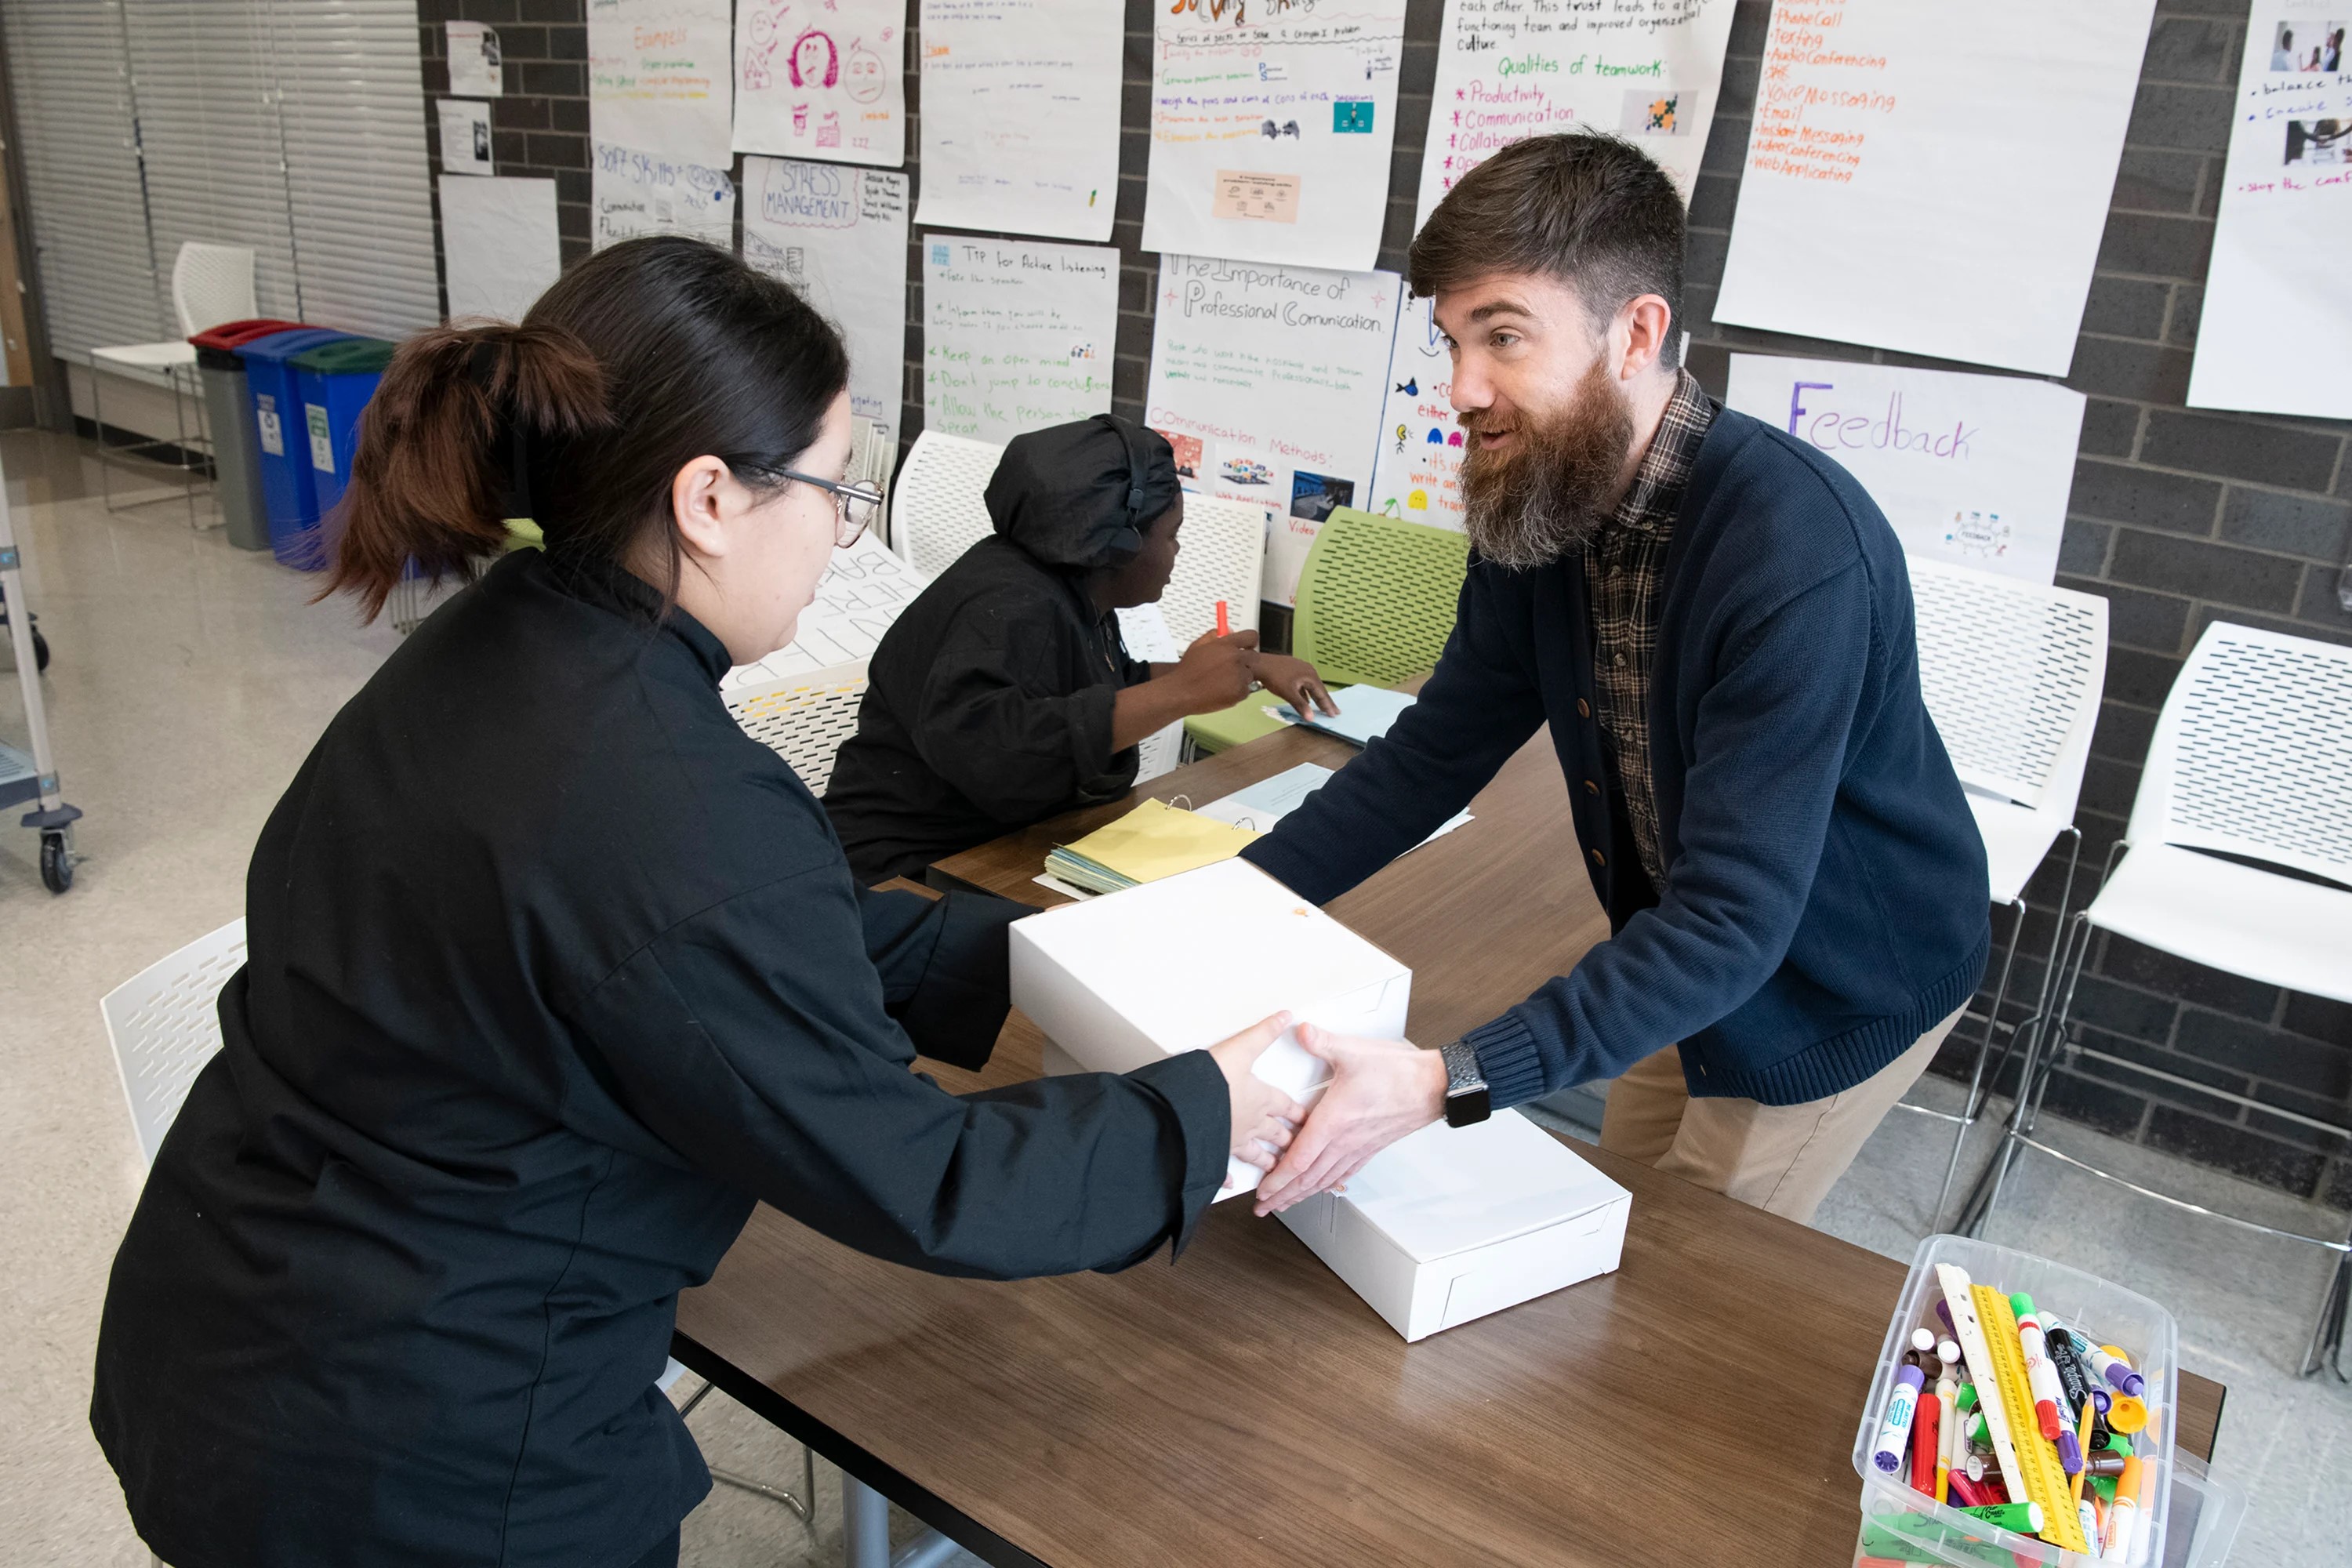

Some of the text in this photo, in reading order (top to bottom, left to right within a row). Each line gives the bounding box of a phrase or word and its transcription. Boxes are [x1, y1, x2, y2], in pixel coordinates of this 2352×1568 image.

[1457, 16, 1516, 38] functioning
[1524, 15, 1552, 31] team
[1559, 16, 1578, 31] and
[1587, 16, 1634, 34] improved
[1814, 9, 1843, 27] Call
[1775, 27, 1823, 49] Texting
[1497, 53, 1559, 78] Qualities
[1570, 54, 1588, 75] of
[1806, 49, 1886, 69] Conferencing
[1469, 79, 1545, 107] Productivity
[2263, 81, 2326, 96] balance
[1465, 100, 1574, 129] Communication
[1762, 101, 1803, 121] Email
[1799, 125, 1864, 147] Messaging
[782, 161, 840, 197] STRESS
[767, 193, 850, 220] MANAGEMENT
[1211, 259, 1321, 296] Importance
[1327, 277, 1350, 299] of
[1185, 279, 1278, 318] Professional
[942, 345, 971, 365] Keep
[981, 354, 995, 365] an
[1003, 354, 1031, 368] open
[988, 378, 1019, 394] jump
[1028, 374, 1041, 387] to
[1417, 404, 1450, 421] either
[1789, 381, 1981, 459] Feedback
[1288, 519, 1316, 536] Video
